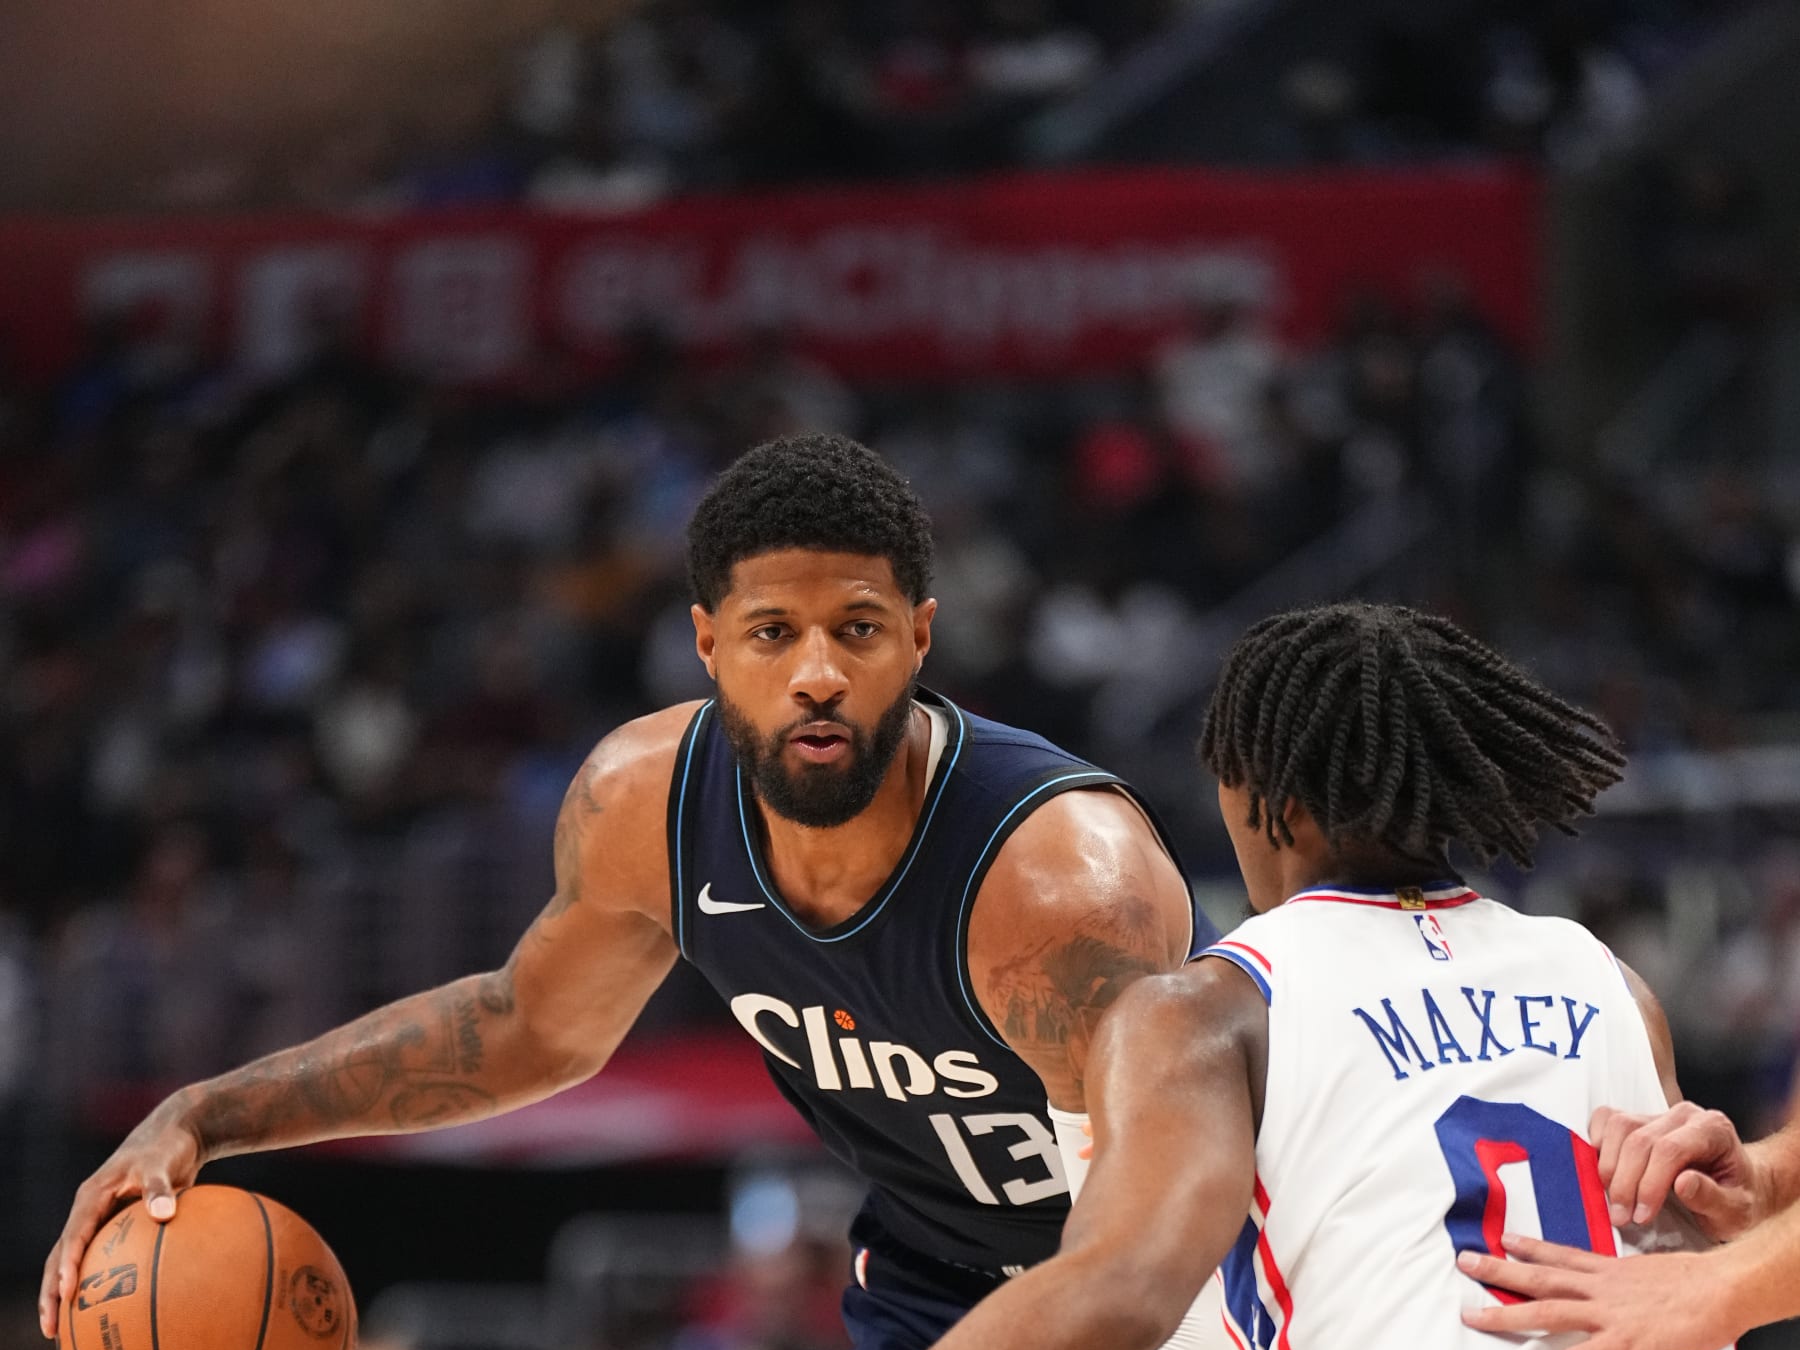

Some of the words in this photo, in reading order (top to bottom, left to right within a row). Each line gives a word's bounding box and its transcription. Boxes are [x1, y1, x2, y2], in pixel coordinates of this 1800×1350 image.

[730, 992, 999, 1102] Clips
[1352, 986, 1600, 1080] MAXEY
[928, 1112, 1071, 1206] 13
[1434, 1094, 1618, 1307] 0
